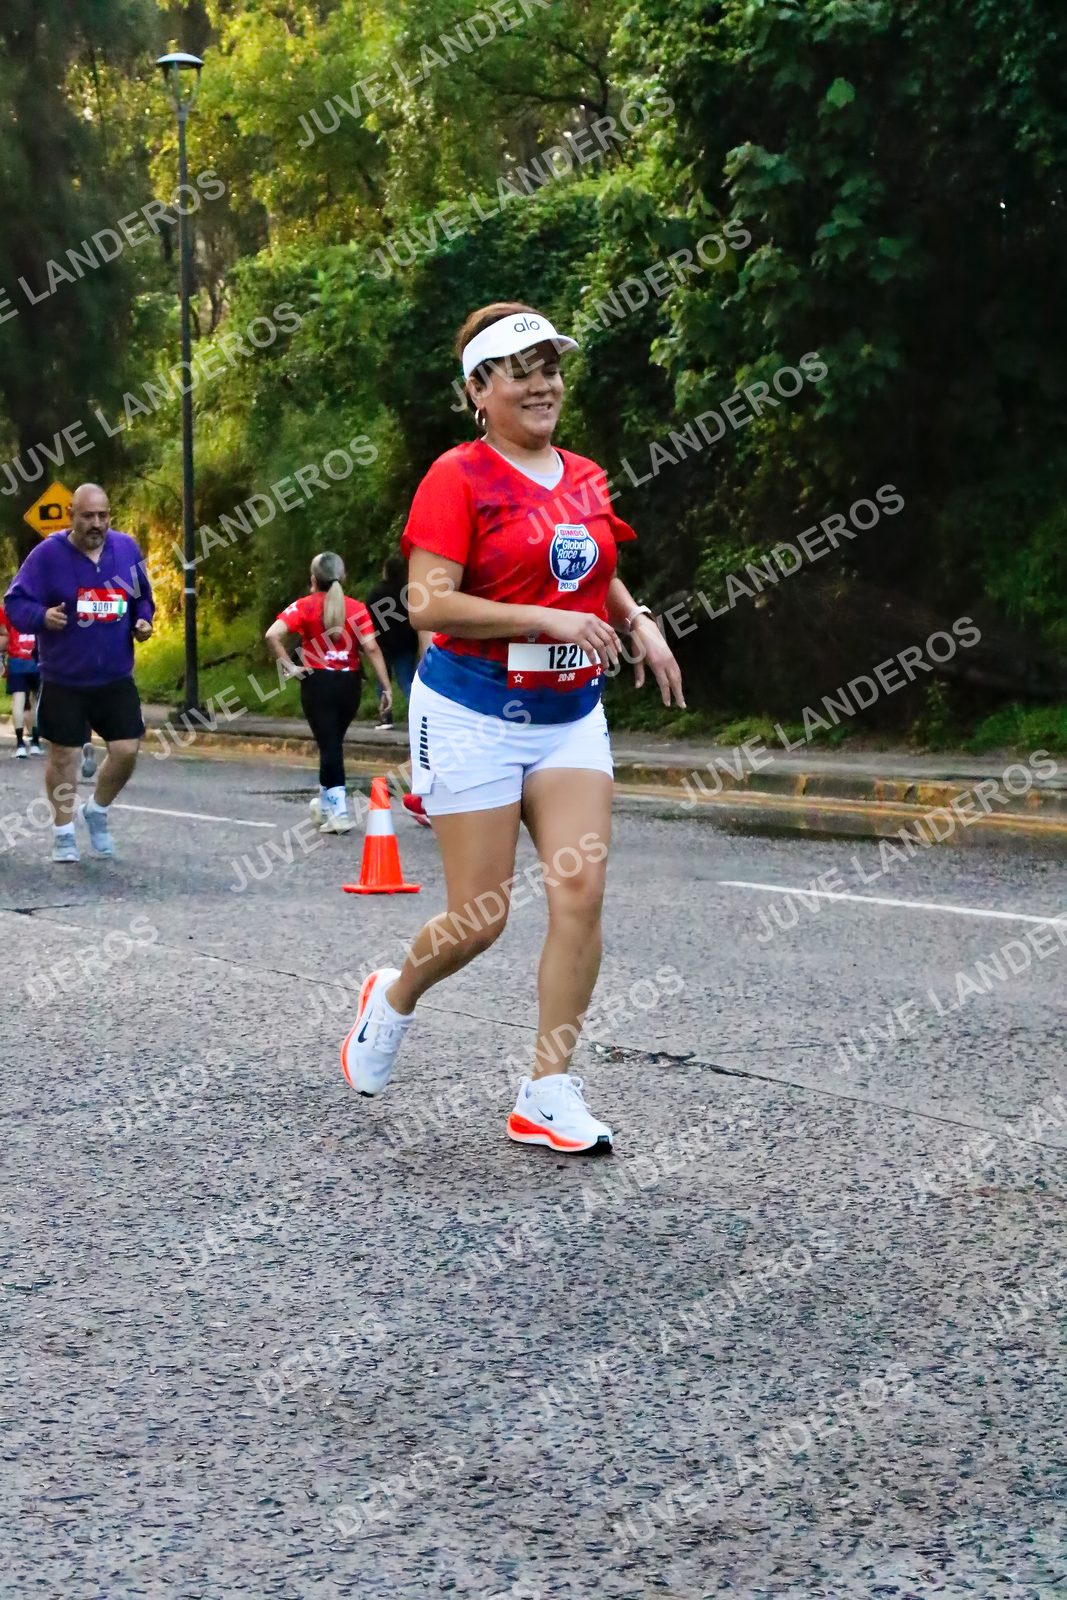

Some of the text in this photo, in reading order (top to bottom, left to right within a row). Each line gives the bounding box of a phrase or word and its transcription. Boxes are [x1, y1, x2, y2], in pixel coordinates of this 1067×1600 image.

[513, 316, 541, 333] alo
[562, 539, 587, 550] Global
[557, 548, 578, 560] Race
[559, 582, 577, 590] 2026
